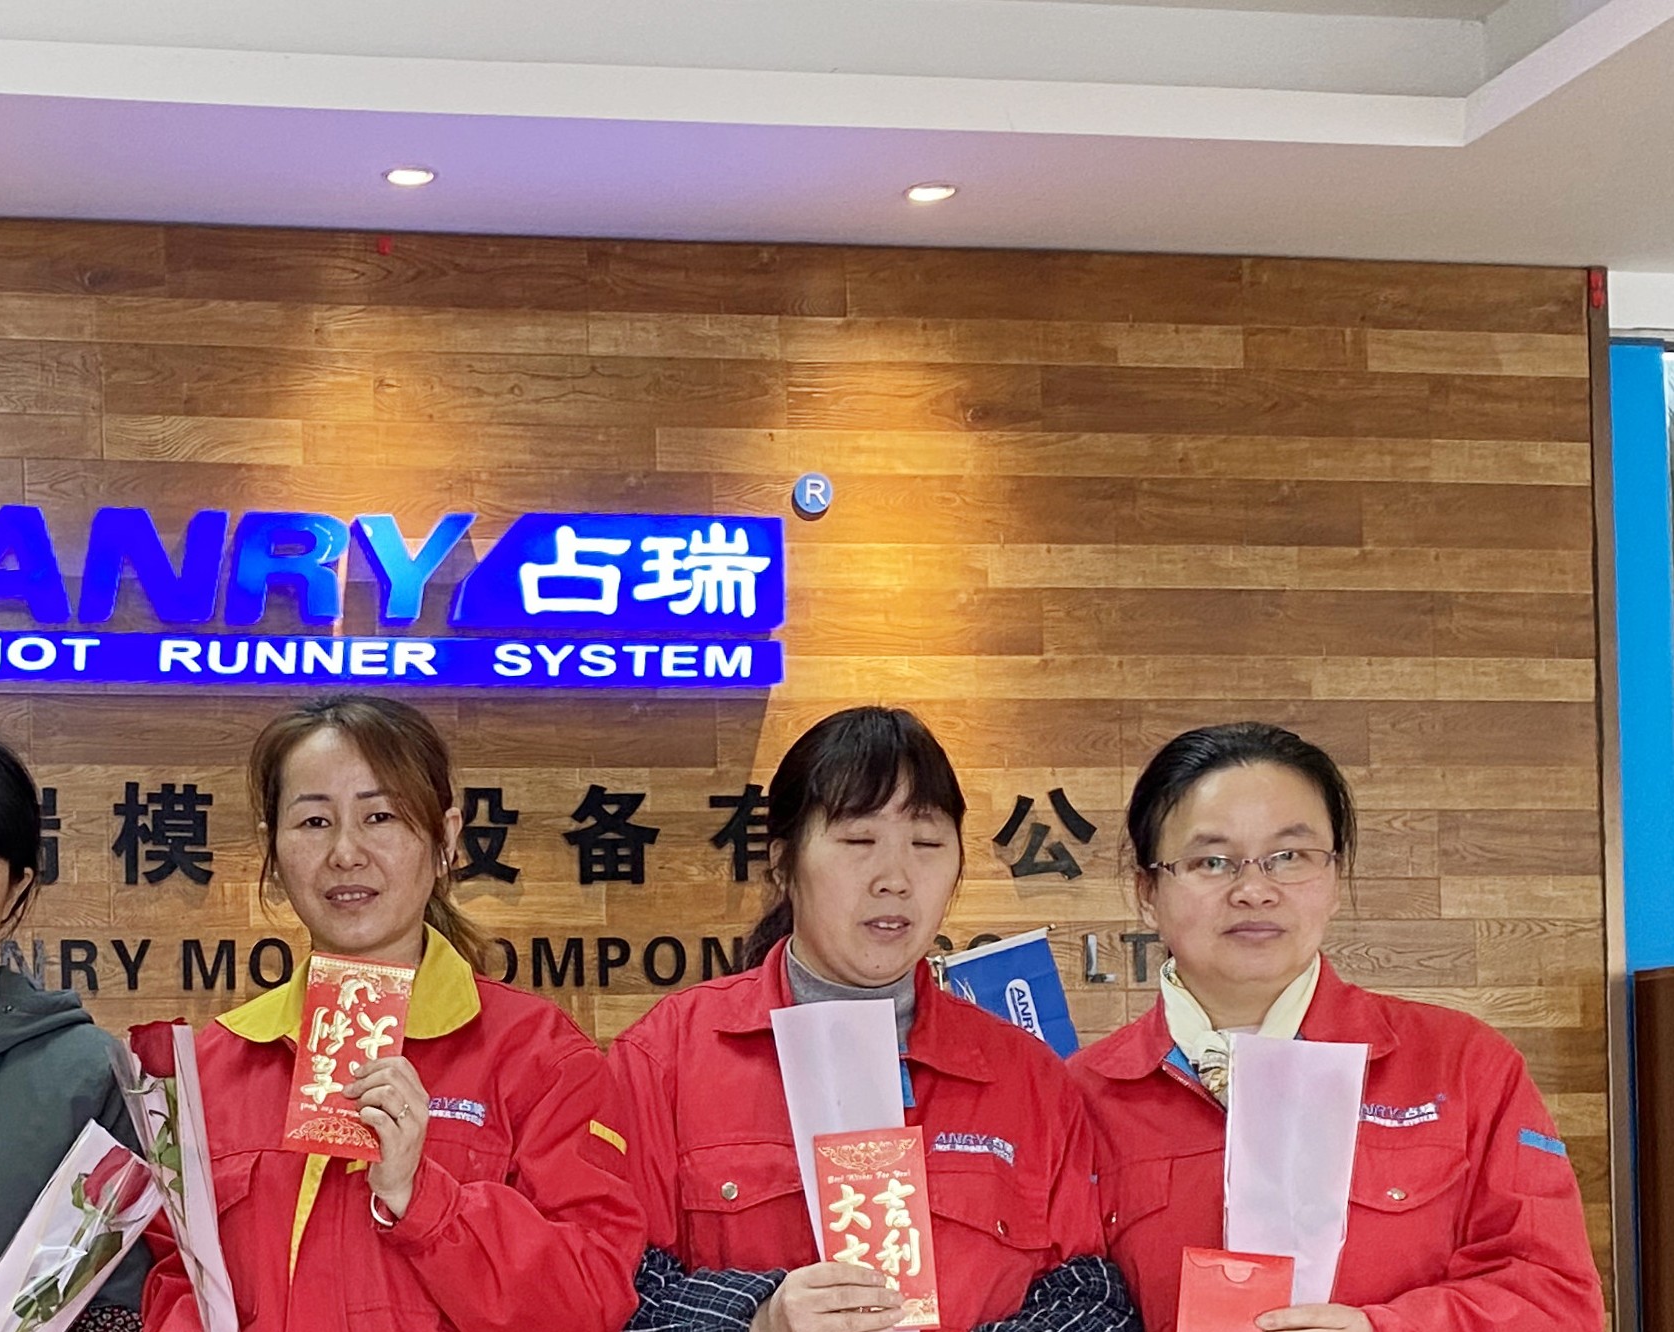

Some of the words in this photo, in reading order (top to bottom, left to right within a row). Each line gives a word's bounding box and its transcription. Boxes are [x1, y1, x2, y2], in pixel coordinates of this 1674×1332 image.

[519, 522, 772, 618] 占瑞
[158, 640, 438, 677] RUNNER
[492, 643, 754, 679] SYSTEM
[0, 938, 152, 991] NRY
[183, 937, 294, 991] MO
[1082, 933, 1161, 983] LT
